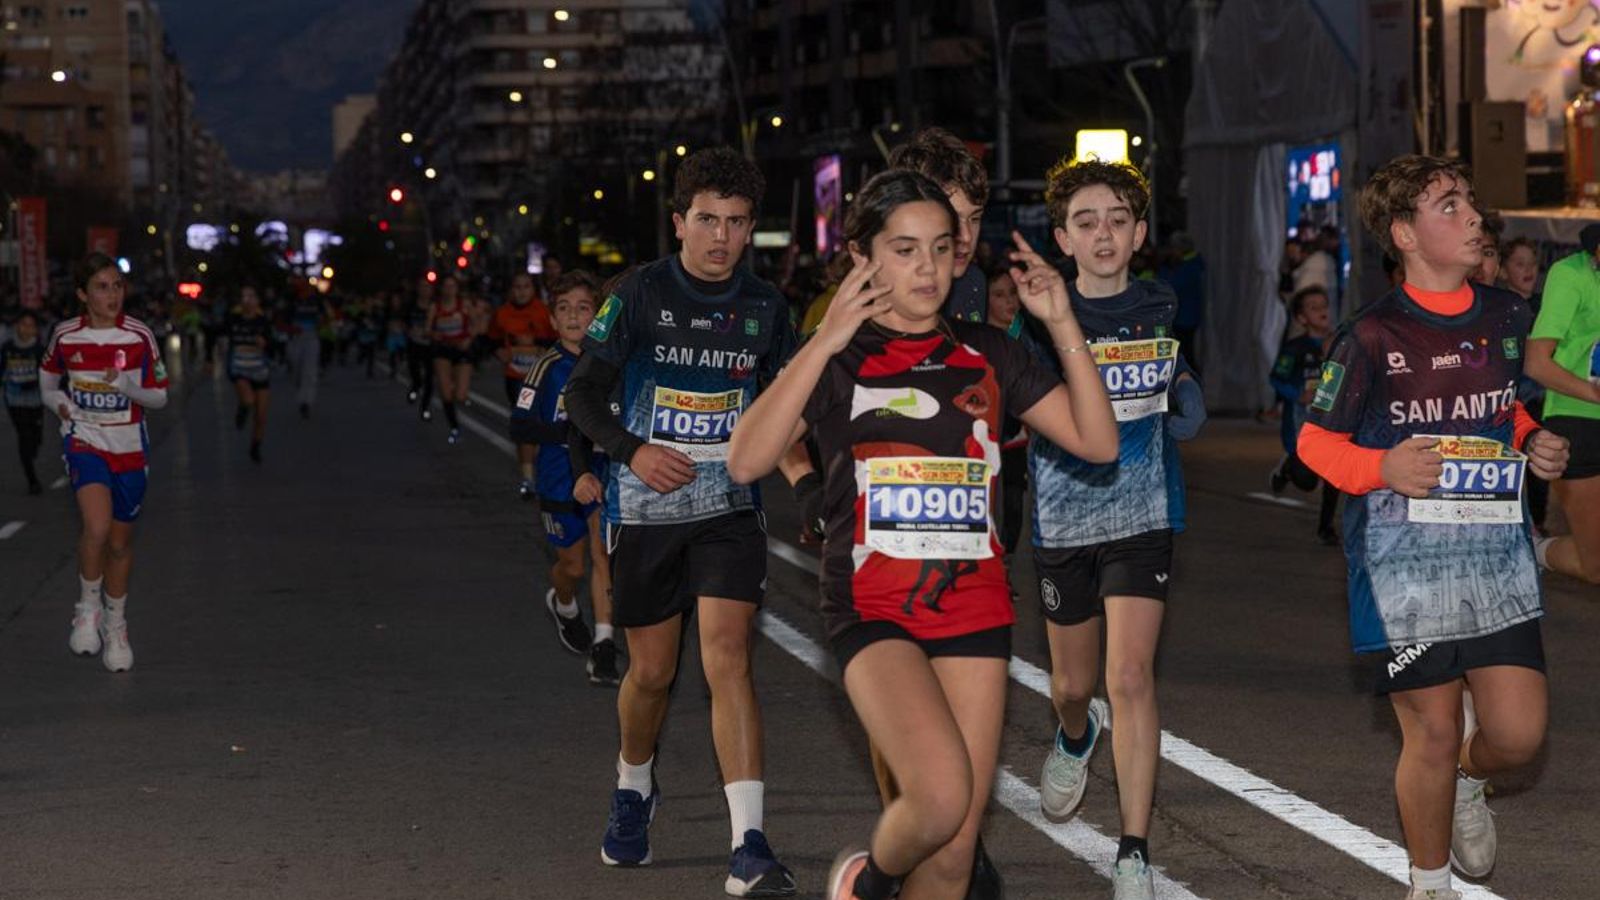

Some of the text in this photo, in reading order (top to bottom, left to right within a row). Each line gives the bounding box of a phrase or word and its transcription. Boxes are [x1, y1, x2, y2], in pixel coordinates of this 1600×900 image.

[655, 345, 757, 370] SAN ANTÓN
[1105, 346, 1121, 359] 42
[1432, 349, 1461, 370] jaén
[1099, 360, 1172, 391] 0364
[75, 392, 128, 408] 11097
[676, 394, 694, 409] 42
[1389, 398, 1442, 425] SAN
[657, 408, 738, 436] 10570
[1438, 441, 1459, 456] 42
[1439, 463, 1515, 489] 0791
[872, 486, 986, 520] 10905
[1386, 642, 1433, 680] ARM
